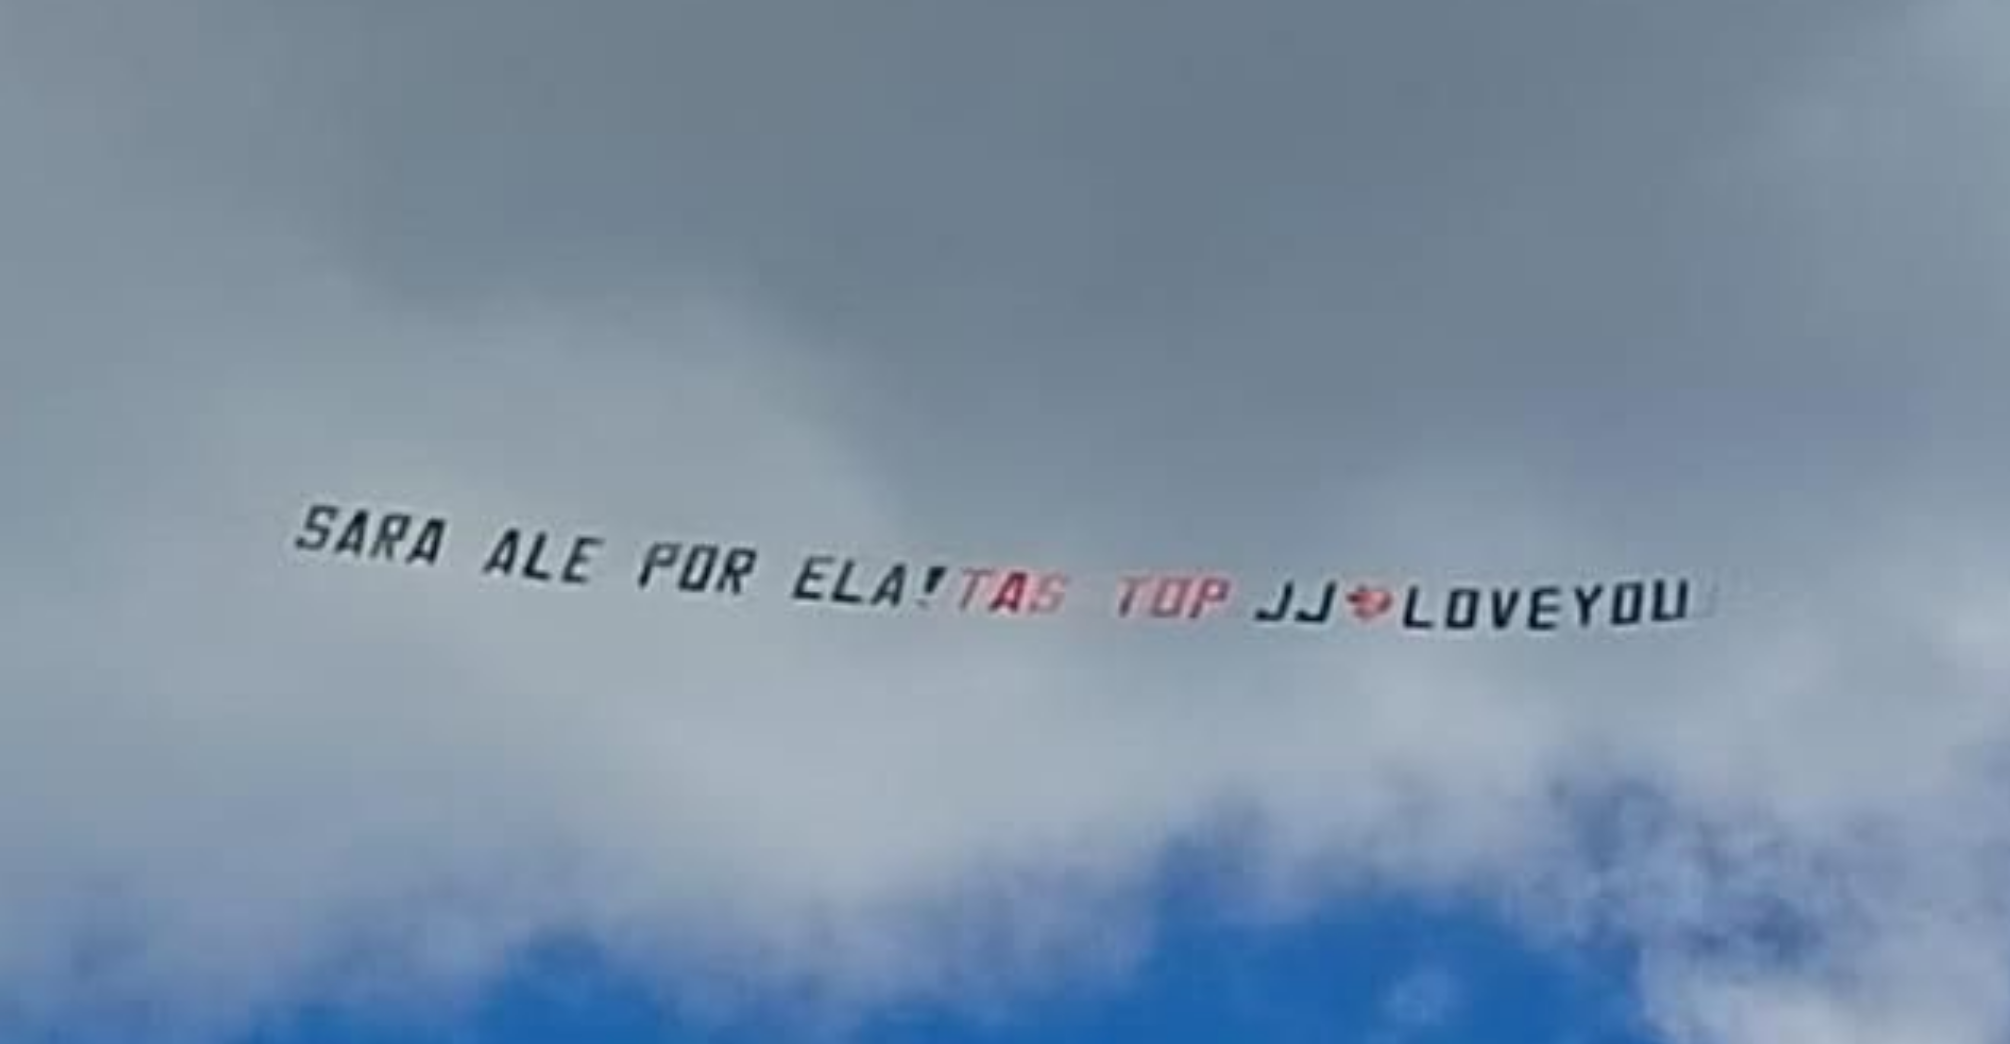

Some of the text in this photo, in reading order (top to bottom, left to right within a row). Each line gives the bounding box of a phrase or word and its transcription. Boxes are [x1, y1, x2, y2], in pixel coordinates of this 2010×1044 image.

[295, 504, 447, 566] SARA
[482, 528, 604, 585] ALE
[638, 541, 758, 595] POR
[791, 555, 948, 608] ELA!
[957, 567, 1069, 614] TAS
[1116, 575, 1232, 619] TOP
[1253, 580, 1337, 624] JJ
